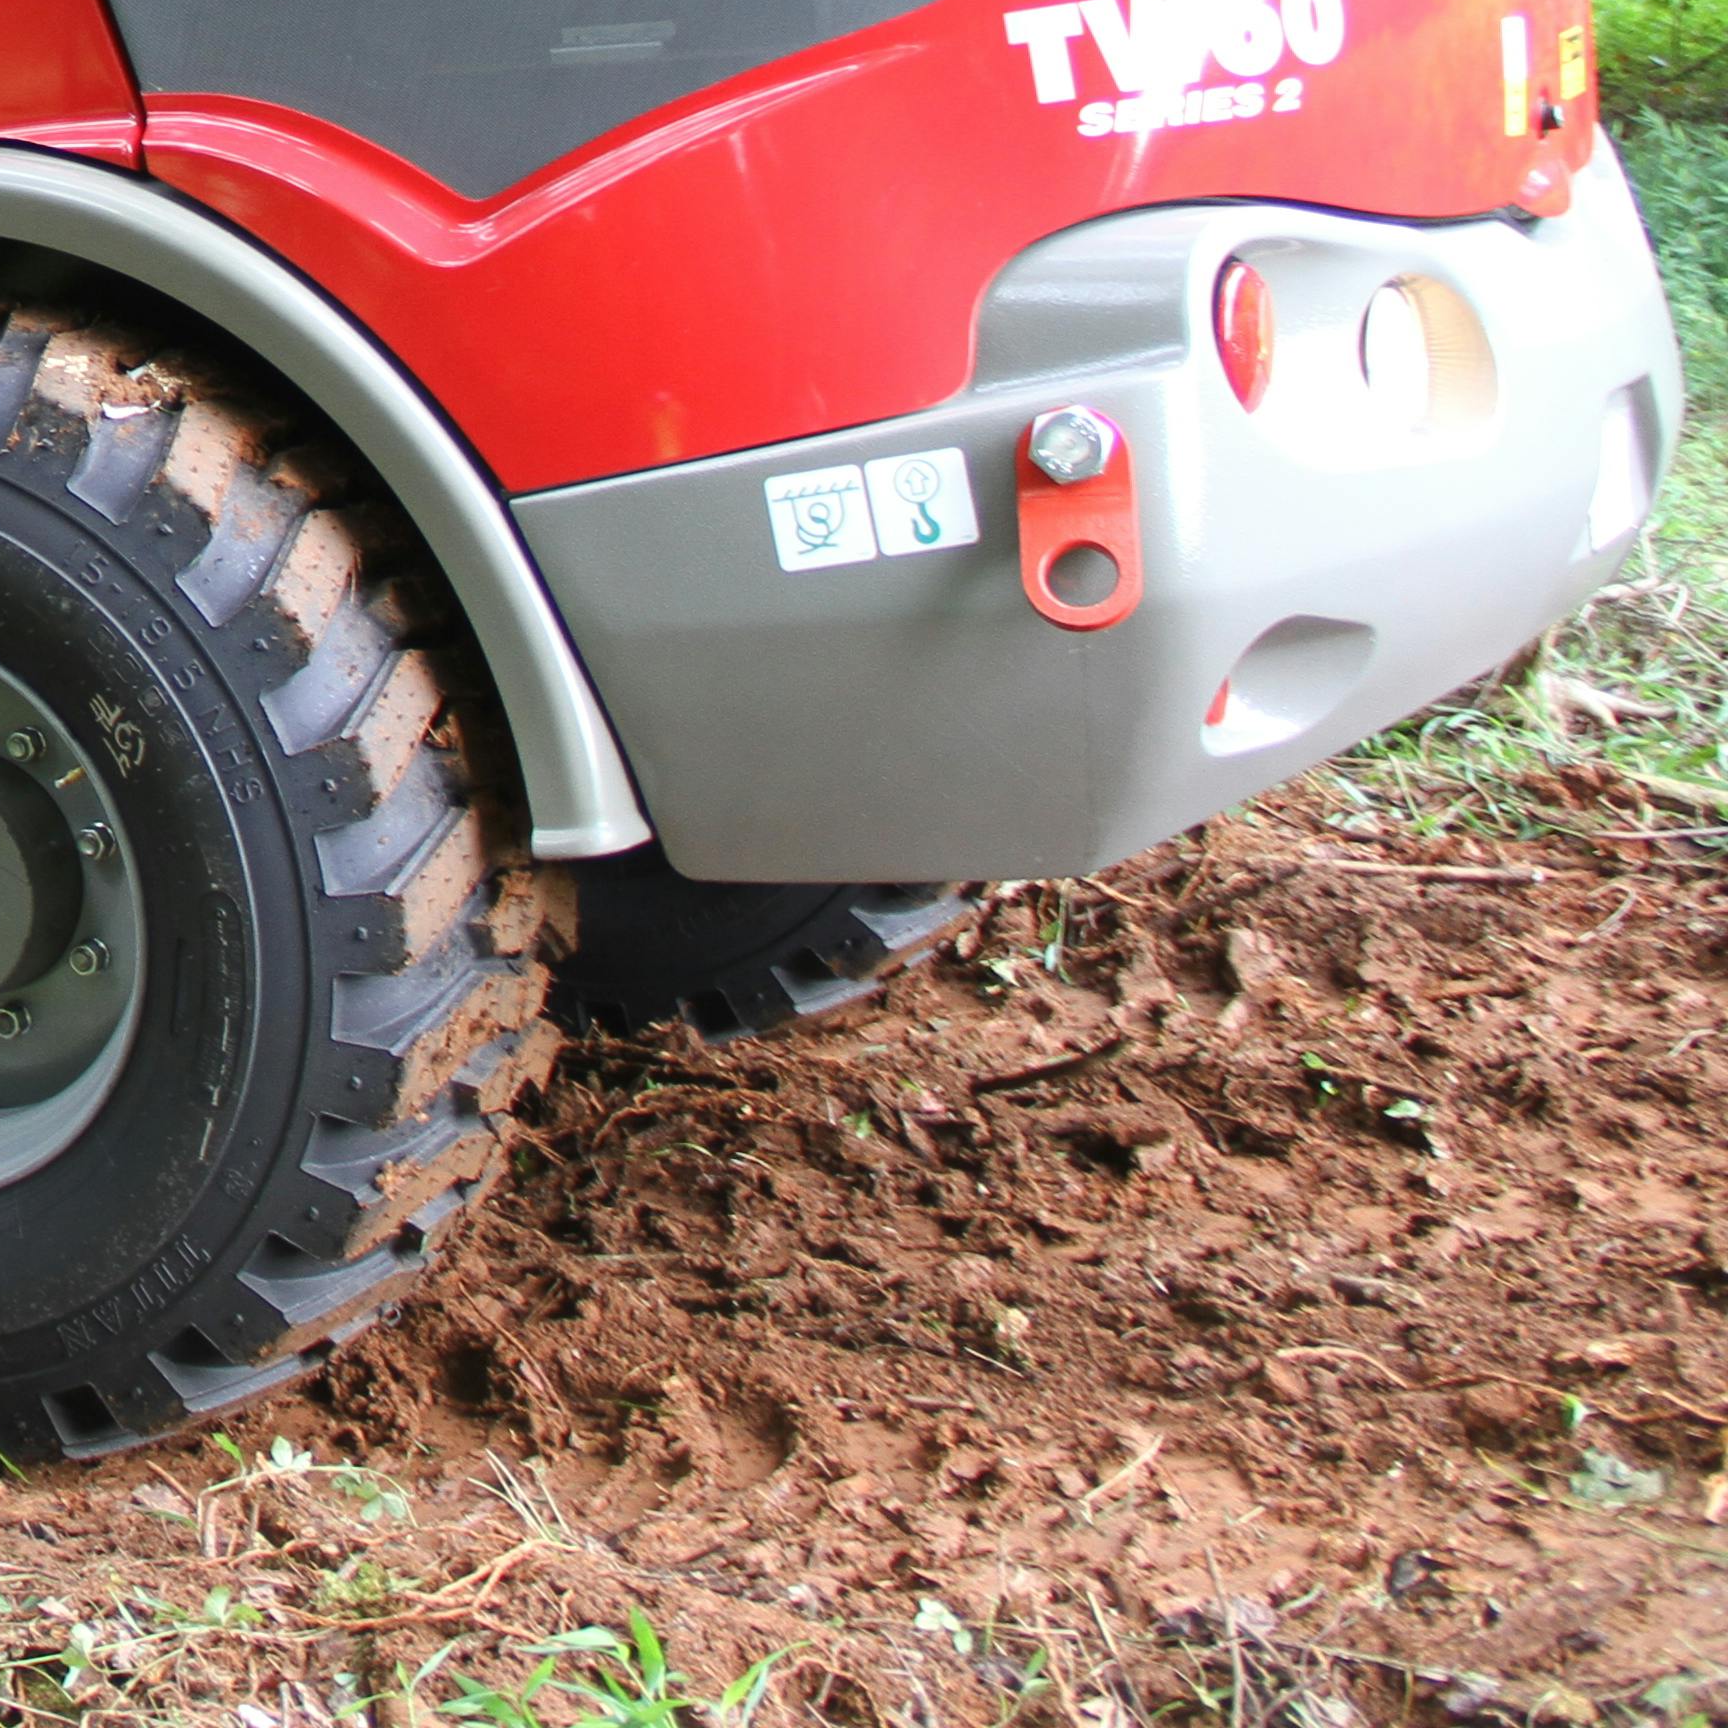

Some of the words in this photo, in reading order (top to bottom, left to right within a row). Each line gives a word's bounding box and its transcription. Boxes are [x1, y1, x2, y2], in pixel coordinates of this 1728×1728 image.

[1076, 82, 1265, 138] SERIES
[1272, 77, 1304, 113] 2
[55, 1232, 213, 1358] TITAN
